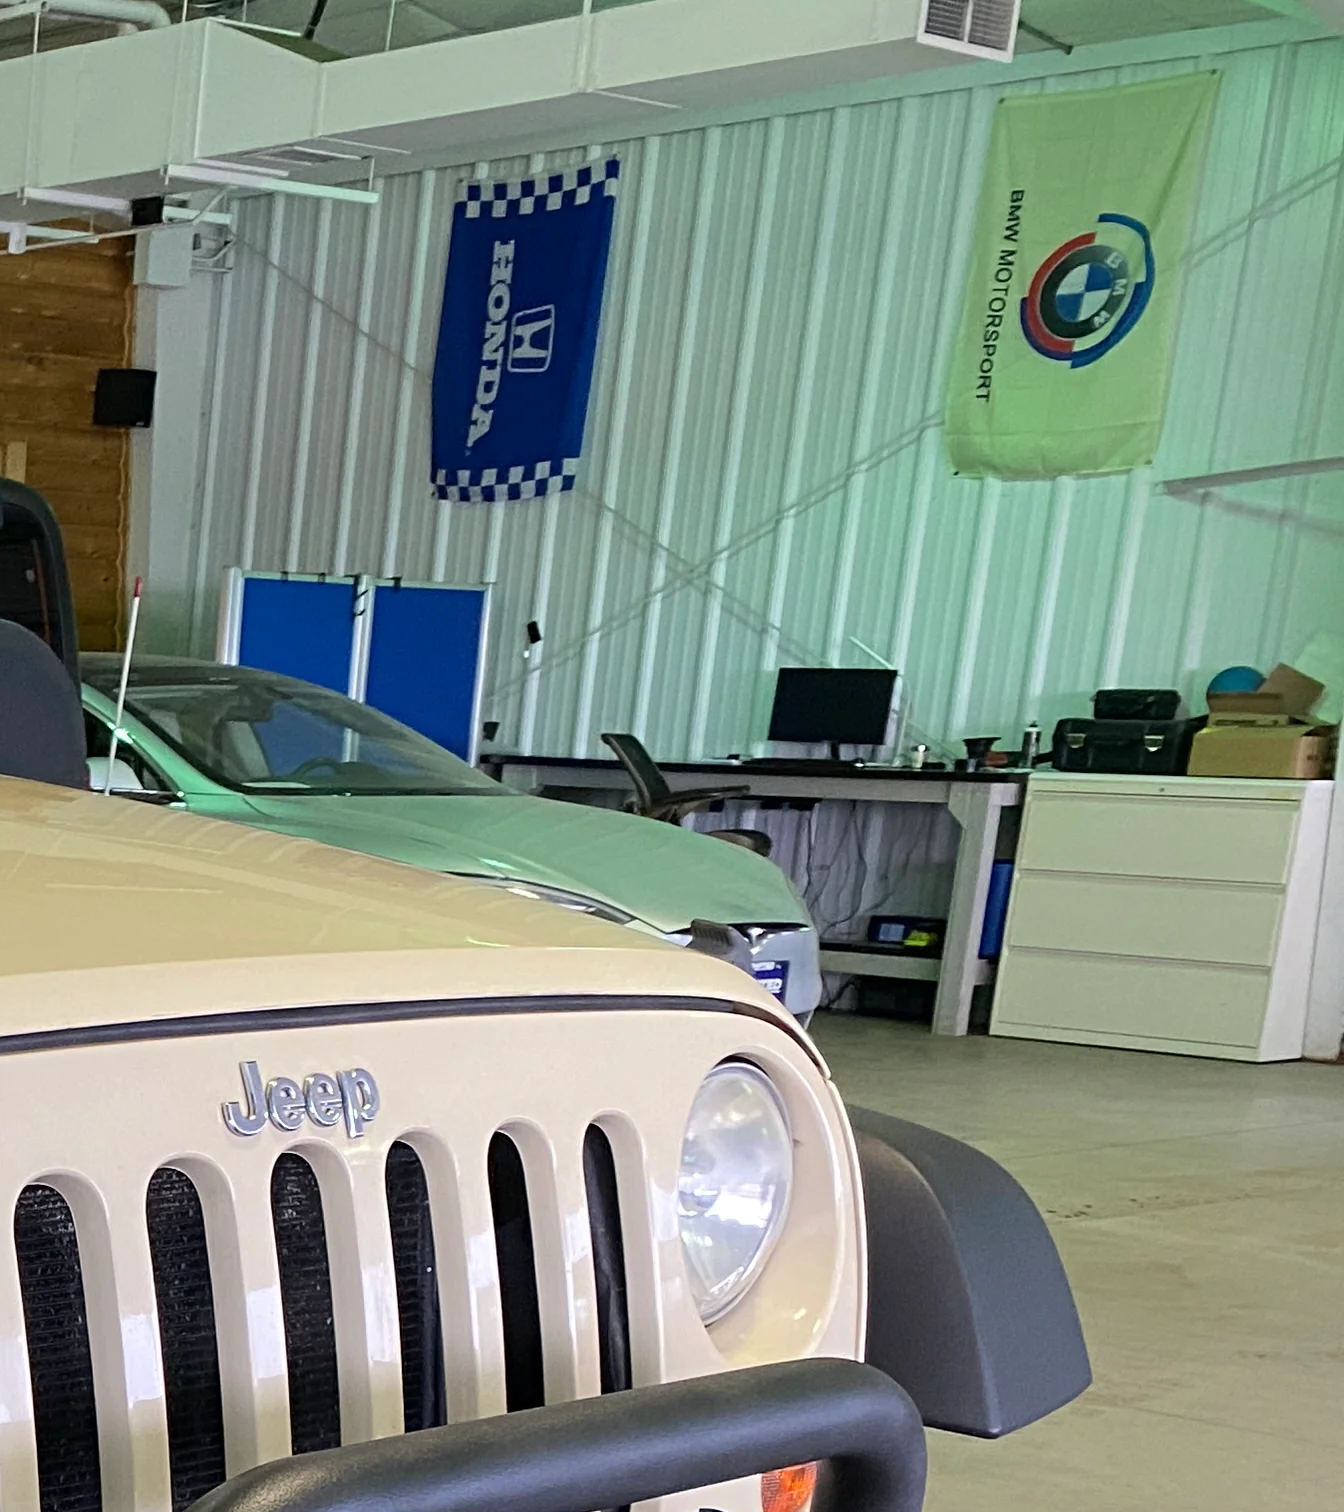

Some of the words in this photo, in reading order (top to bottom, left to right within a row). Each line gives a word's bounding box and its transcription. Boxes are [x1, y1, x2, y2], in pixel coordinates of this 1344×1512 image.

[1007, 188, 1026, 244] BMW
[465, 239, 516, 449] HONDA
[975, 248, 1016, 403] MOTORSPORT
[221, 1060, 381, 1139] Jeep
